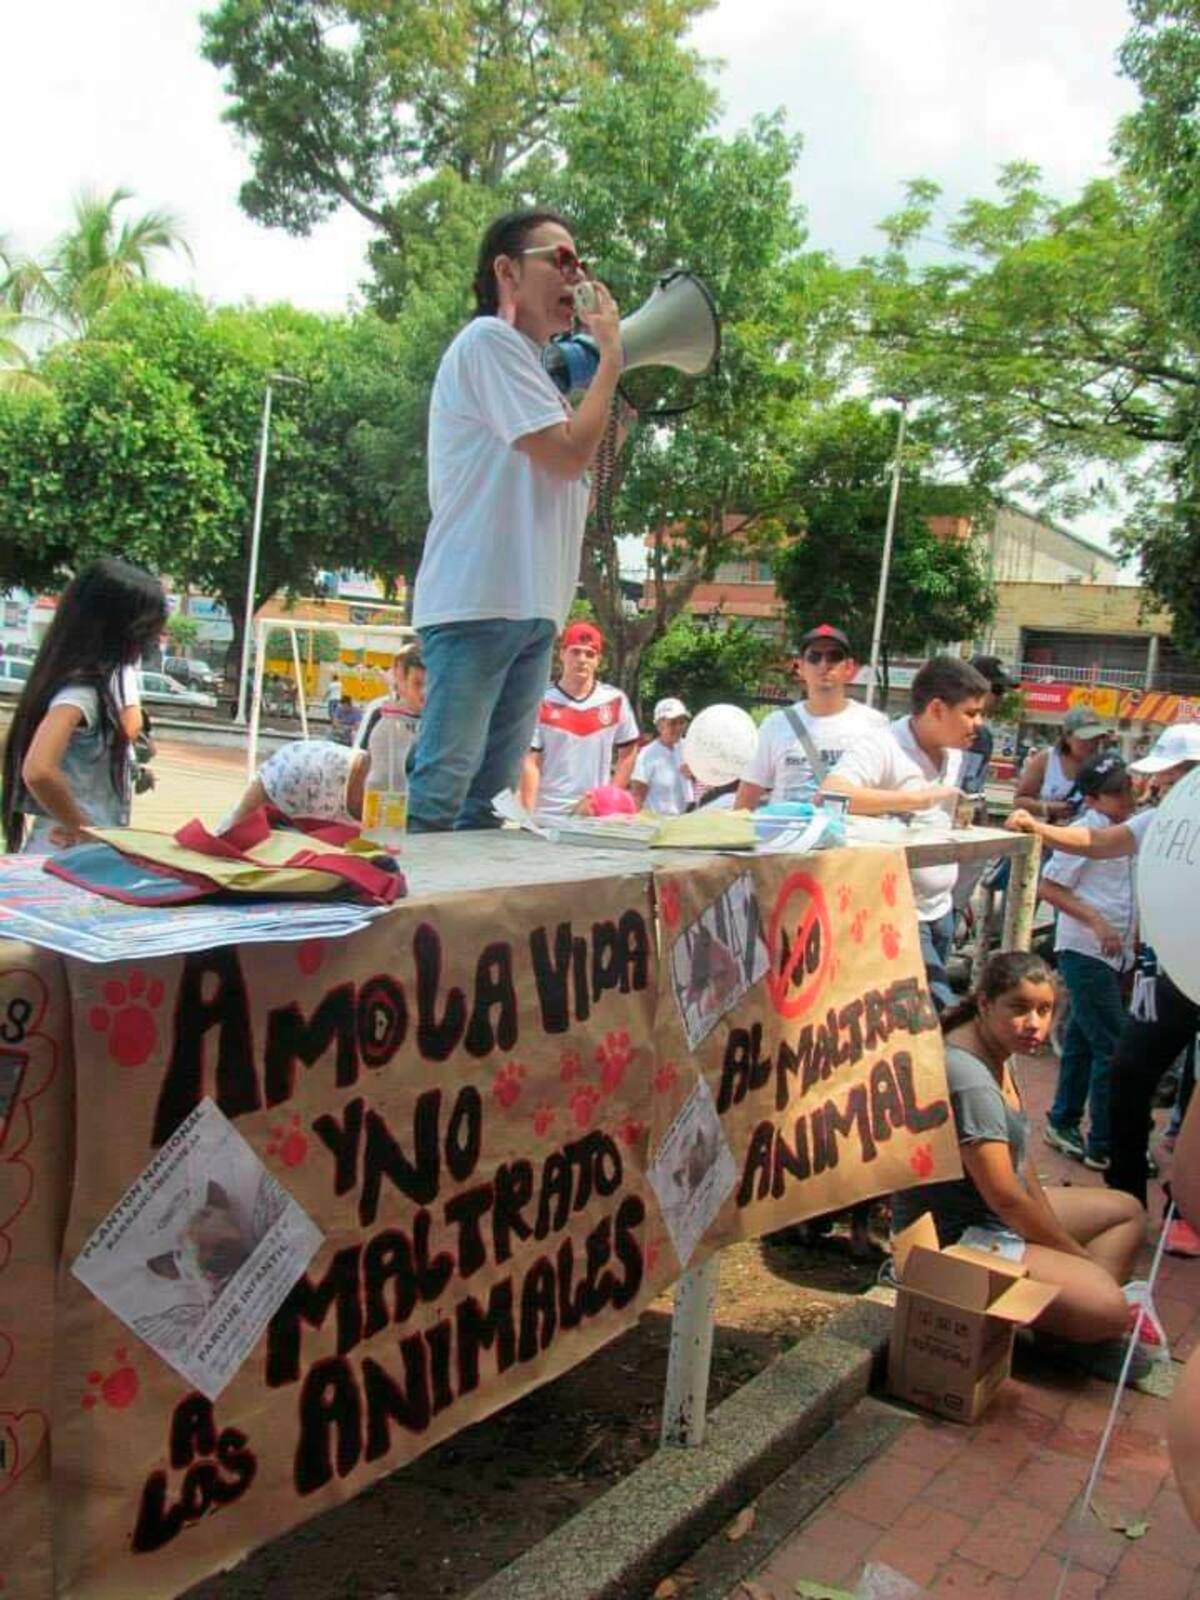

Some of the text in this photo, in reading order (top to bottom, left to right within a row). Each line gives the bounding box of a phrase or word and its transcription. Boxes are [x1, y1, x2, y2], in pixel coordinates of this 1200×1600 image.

[777, 917, 822, 998] NO
[151, 909, 650, 1148] AMO LA VIDA
[716, 1022, 773, 1115] AL
[142, 1106, 205, 1185] NACIONAL
[311, 1084, 483, 1228] Y NO
[735, 1050, 950, 1208] ANIMAL
[198, 1306, 242, 1363] PARQUE
[241, 1242, 290, 1306] INFANTIL
[265, 1129, 624, 1388] MALTRATO
[131, 1428, 259, 1555] LOS
[294, 1194, 646, 1496] ANIMALES
[169, 1392, 218, 1470] A
